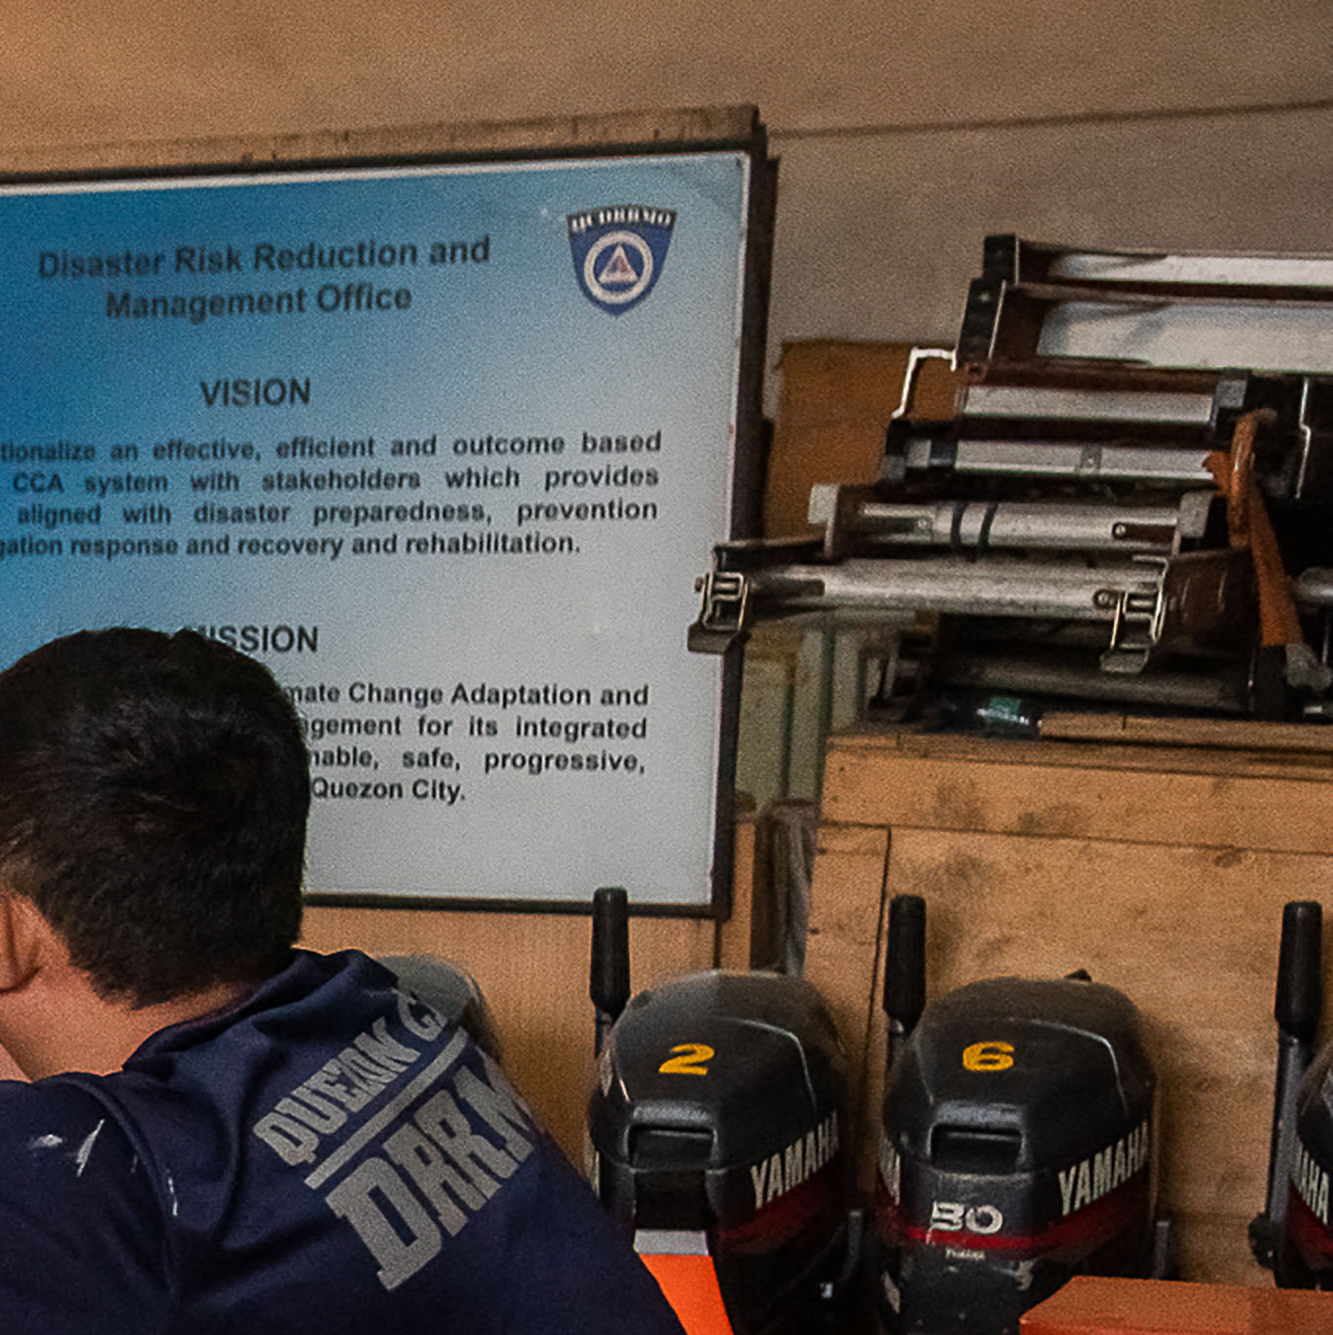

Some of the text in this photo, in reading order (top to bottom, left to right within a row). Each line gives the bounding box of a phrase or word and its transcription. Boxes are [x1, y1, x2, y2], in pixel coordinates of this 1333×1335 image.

[38, 236, 491, 279] Disaster Risk Reduction and
[106, 283, 412, 324] Management Office
[200, 377, 312, 407] VISION
[110, 443, 138, 461] an
[153, 438, 261, 464] effective,
[276, 435, 374, 458] efficient
[390, 434, 437, 457] and
[452, 433, 565, 455] outcome
[582, 430, 662, 454] based
[12, 472, 64, 493] CCA
[85, 472, 167, 497] system
[191, 471, 239, 491] with
[262, 467, 421, 490] stakeholders
[445, 466, 520, 488] which
[545, 464, 659, 492] provides
[17, 504, 101, 529] aligned
[122, 503, 171, 524] with
[194, 502, 290, 524] disaster
[313, 500, 492, 526] preparedness,
[517, 499, 658, 525] prevention
[70, 537, 178, 560] response
[186, 535, 230, 555] and
[238, 536, 344, 560] recovery
[352, 533, 397, 554] and
[405, 531, 580, 554] rehabilitation.
[349, 682, 443, 709] Change
[451, 682, 591, 709] Adaptation
[600, 684, 648, 706] and
[418, 715, 453, 736] for
[469, 715, 498, 736] its
[516, 716, 647, 743] integrated
[403, 746, 461, 771] safe,
[484, 749, 646, 775] progressive,
[312, 777, 465, 805] Quezon City.
[659, 1044, 715, 1076] 2
[963, 1042, 1015, 1071] 6
[252, 1016, 422, 1166] QUEZON
